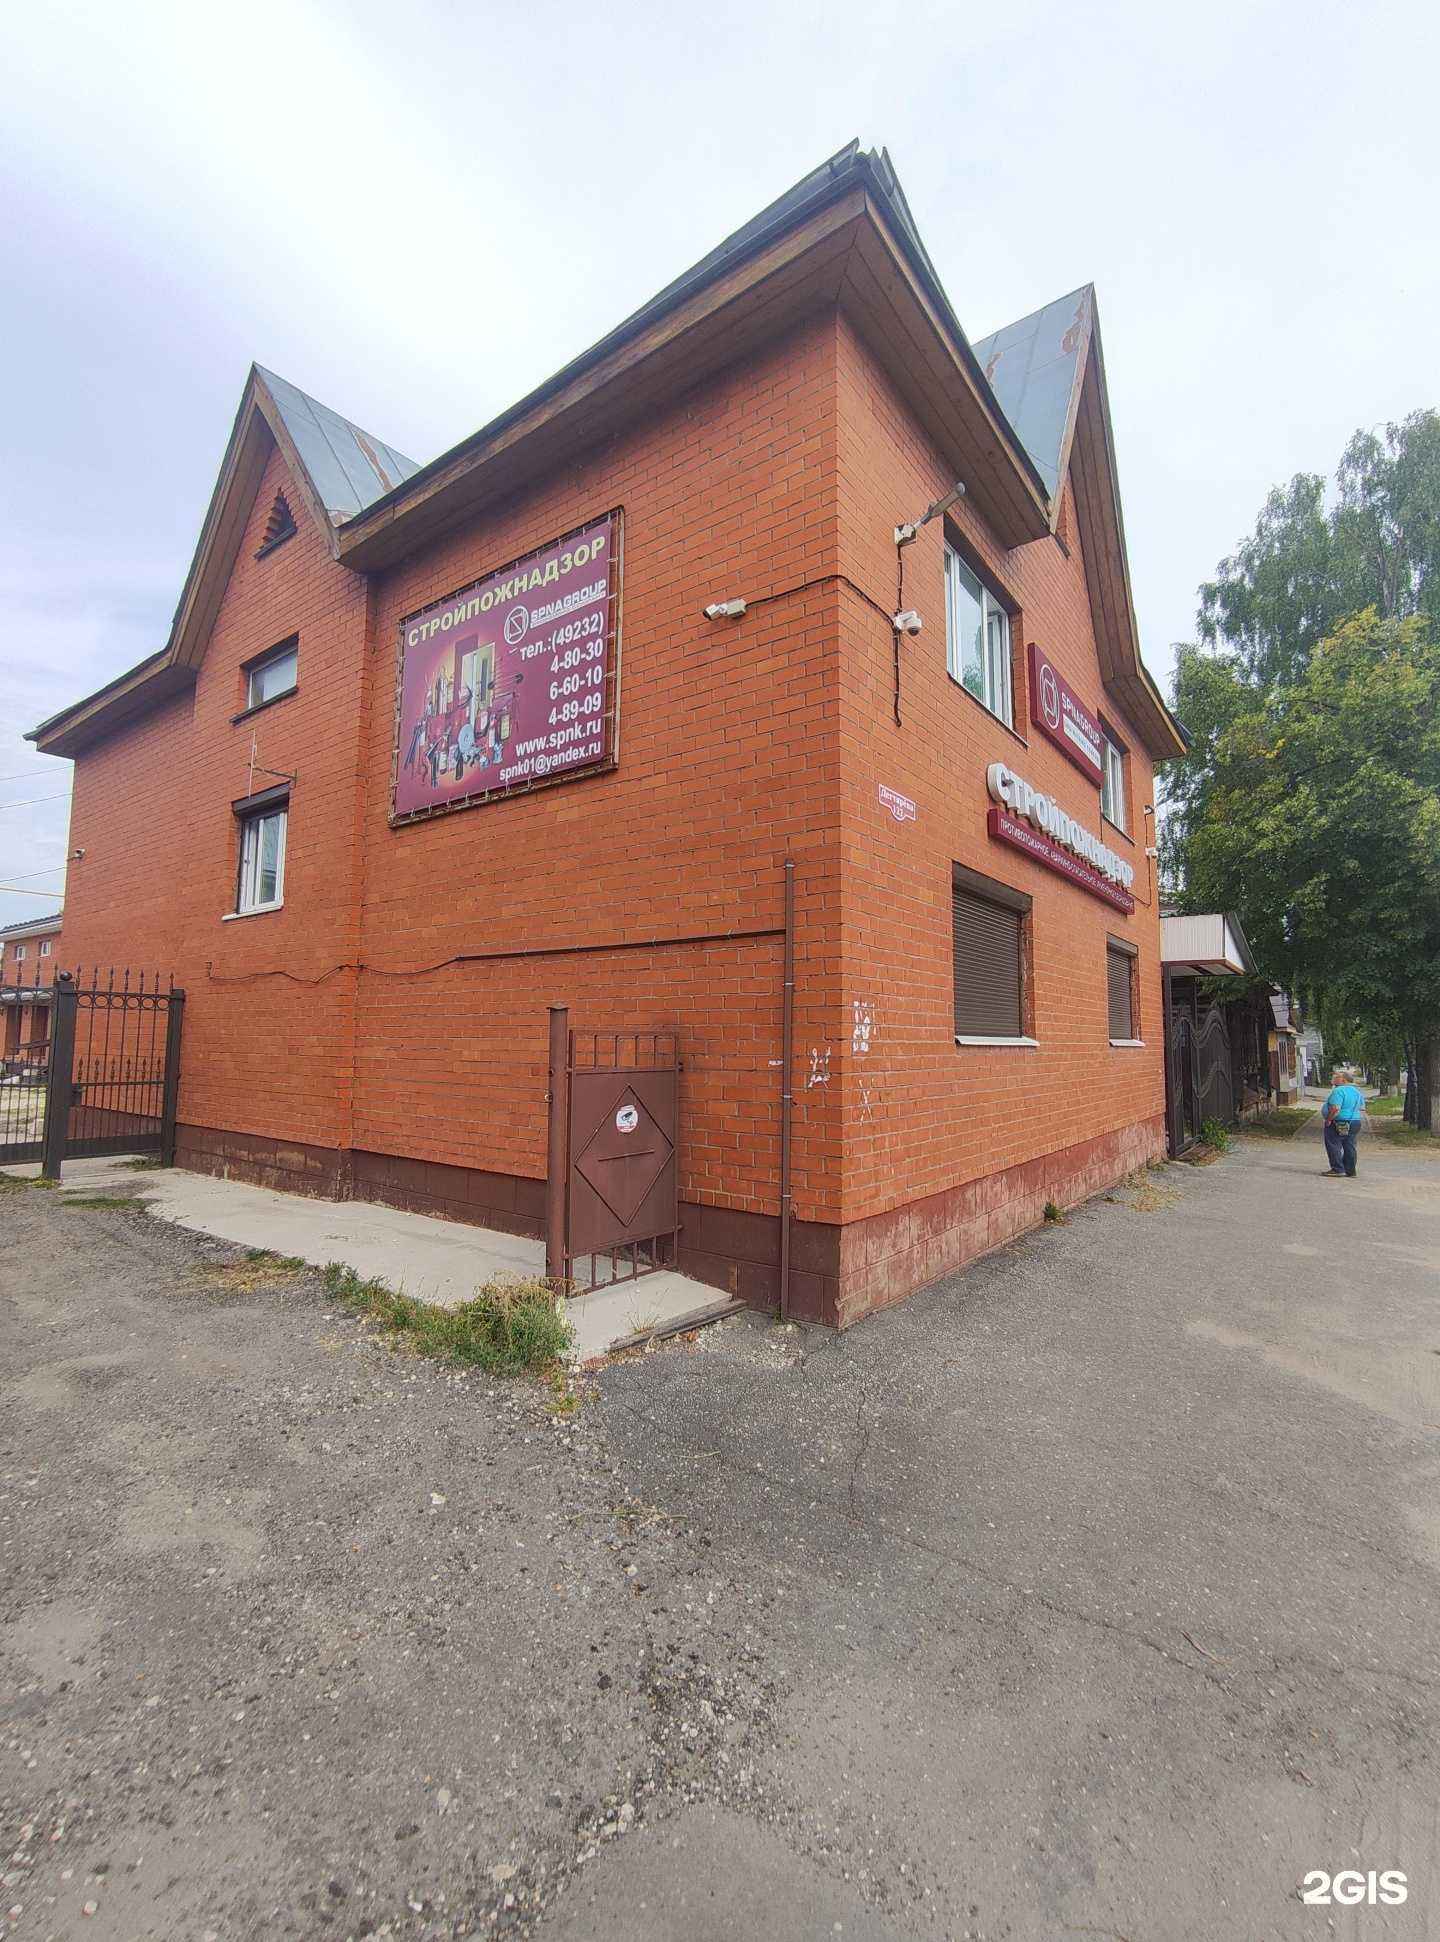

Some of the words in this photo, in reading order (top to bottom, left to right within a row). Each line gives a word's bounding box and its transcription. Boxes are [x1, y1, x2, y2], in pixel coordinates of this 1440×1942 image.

[408, 536, 606, 648] СТРОЙПОЖНАДЗОР
[530, 578, 607, 620] SPNAGROUP
[550, 638, 604, 675] 4-80-30
[549, 666, 603, 701] 6-60-10
[548, 692, 602, 726] 4-89-09
[515, 719, 602, 758] www.spnk.ru
[499, 740, 602, 783] spnk01@yandex.ru
